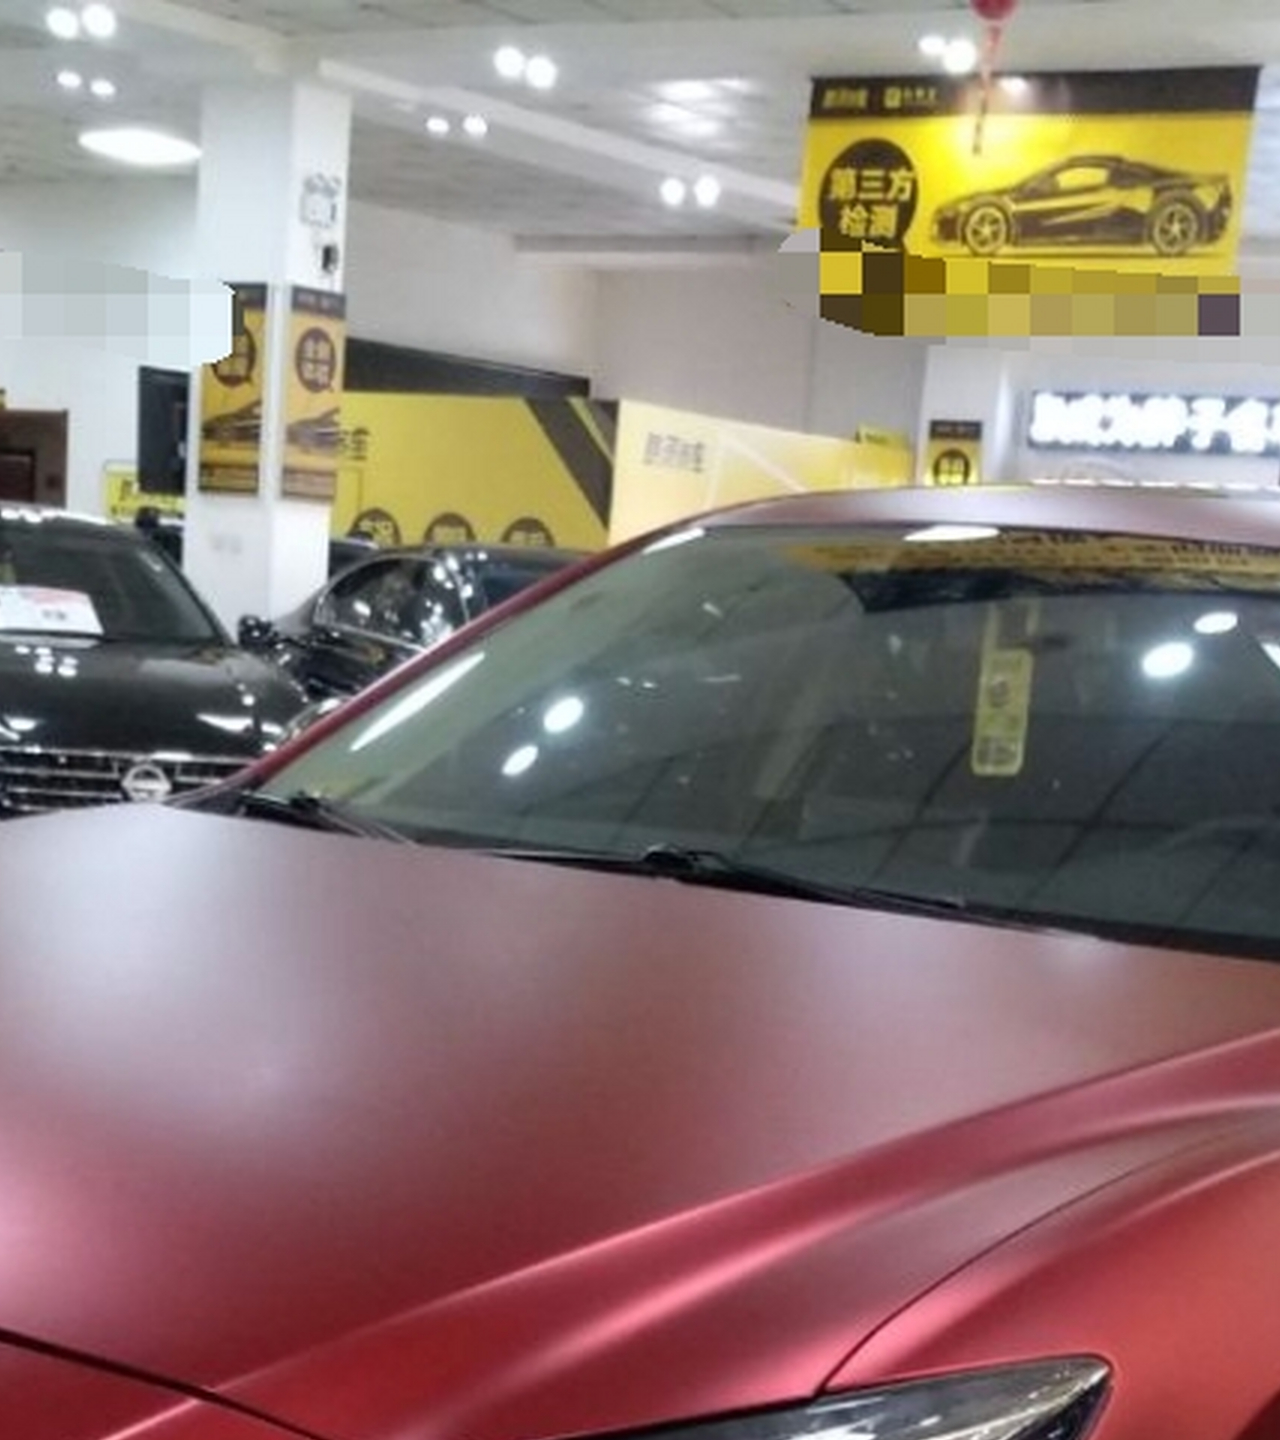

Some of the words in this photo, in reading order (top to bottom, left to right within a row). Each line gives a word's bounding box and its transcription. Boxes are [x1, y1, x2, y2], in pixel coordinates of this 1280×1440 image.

[830, 166, 916, 201] 第三方
[839, 202, 898, 239] 检测
